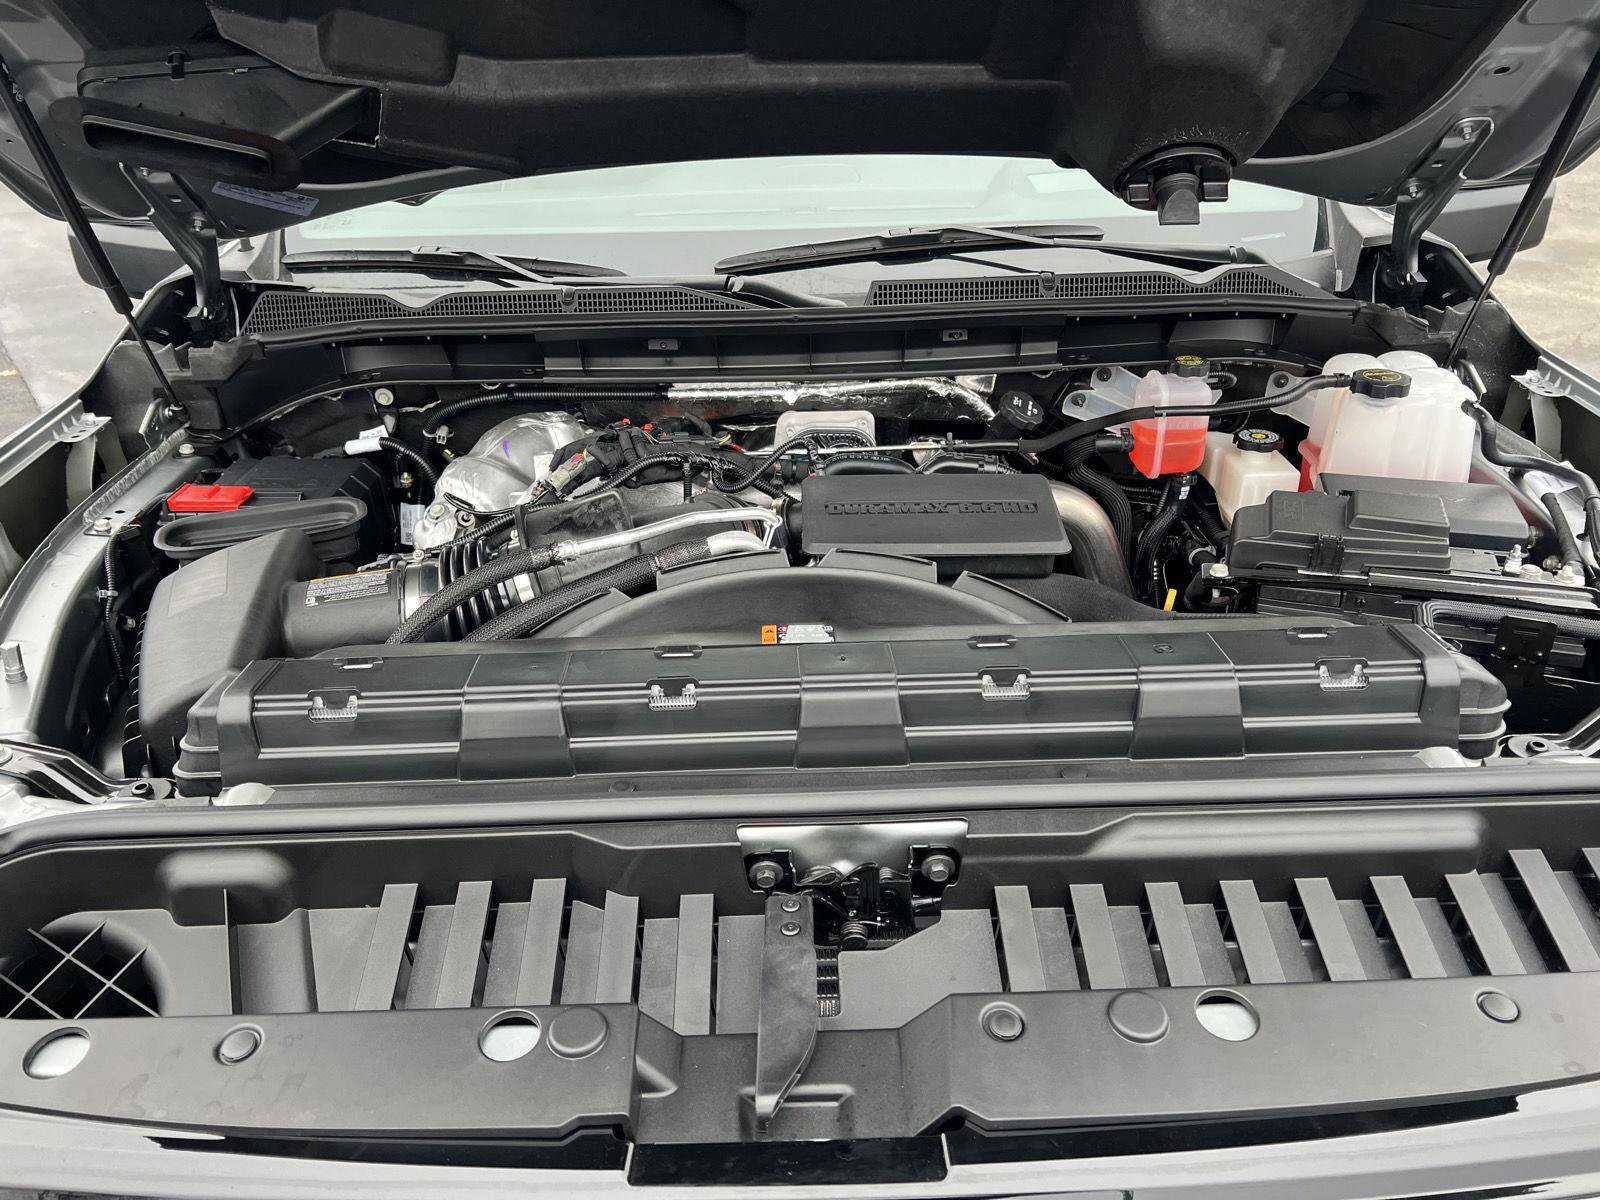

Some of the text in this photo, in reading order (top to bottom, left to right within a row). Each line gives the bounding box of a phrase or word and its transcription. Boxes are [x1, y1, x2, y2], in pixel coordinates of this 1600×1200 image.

[825, 502, 1039, 515] DURAMAX 6.6 HD
